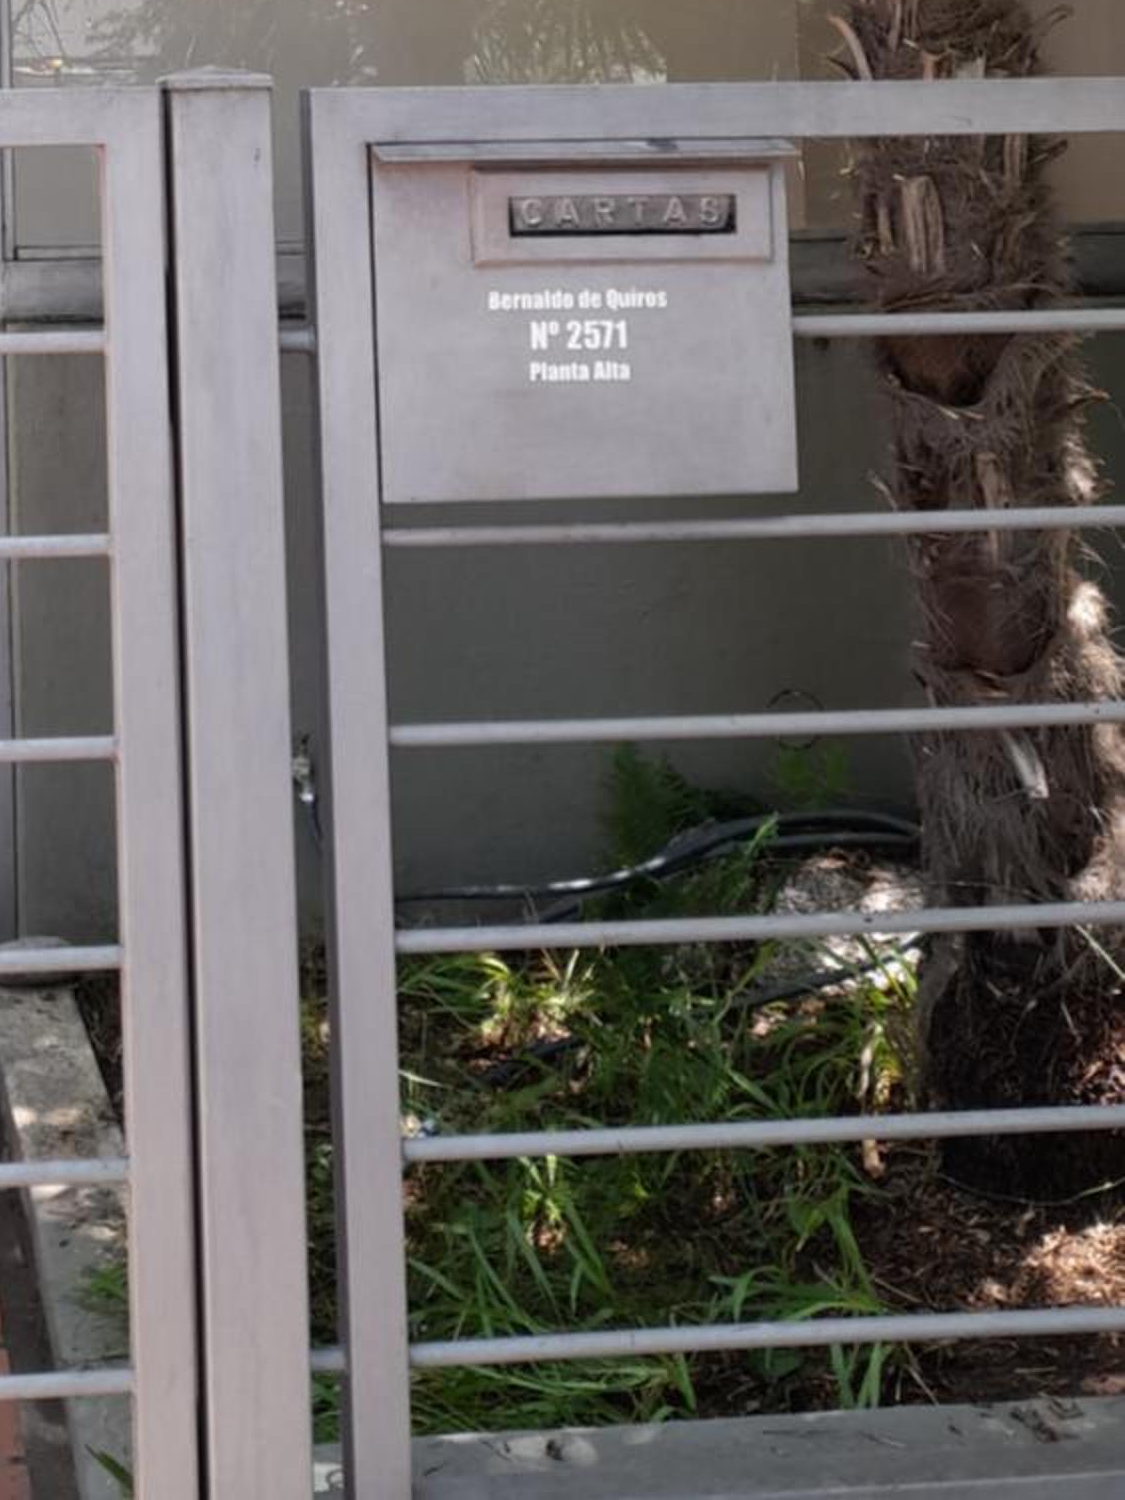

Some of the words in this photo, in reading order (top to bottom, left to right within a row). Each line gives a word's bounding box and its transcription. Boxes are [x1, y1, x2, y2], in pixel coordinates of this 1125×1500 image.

[520, 195, 722, 229] CARTAS
[488, 289, 574, 310] Bernaldo
[578, 289, 601, 309] de
[606, 287, 668, 310] Quiros
[566, 319, 628, 350] 2571
[529, 361, 590, 381] Planta
[593, 360, 632, 381] Alta
